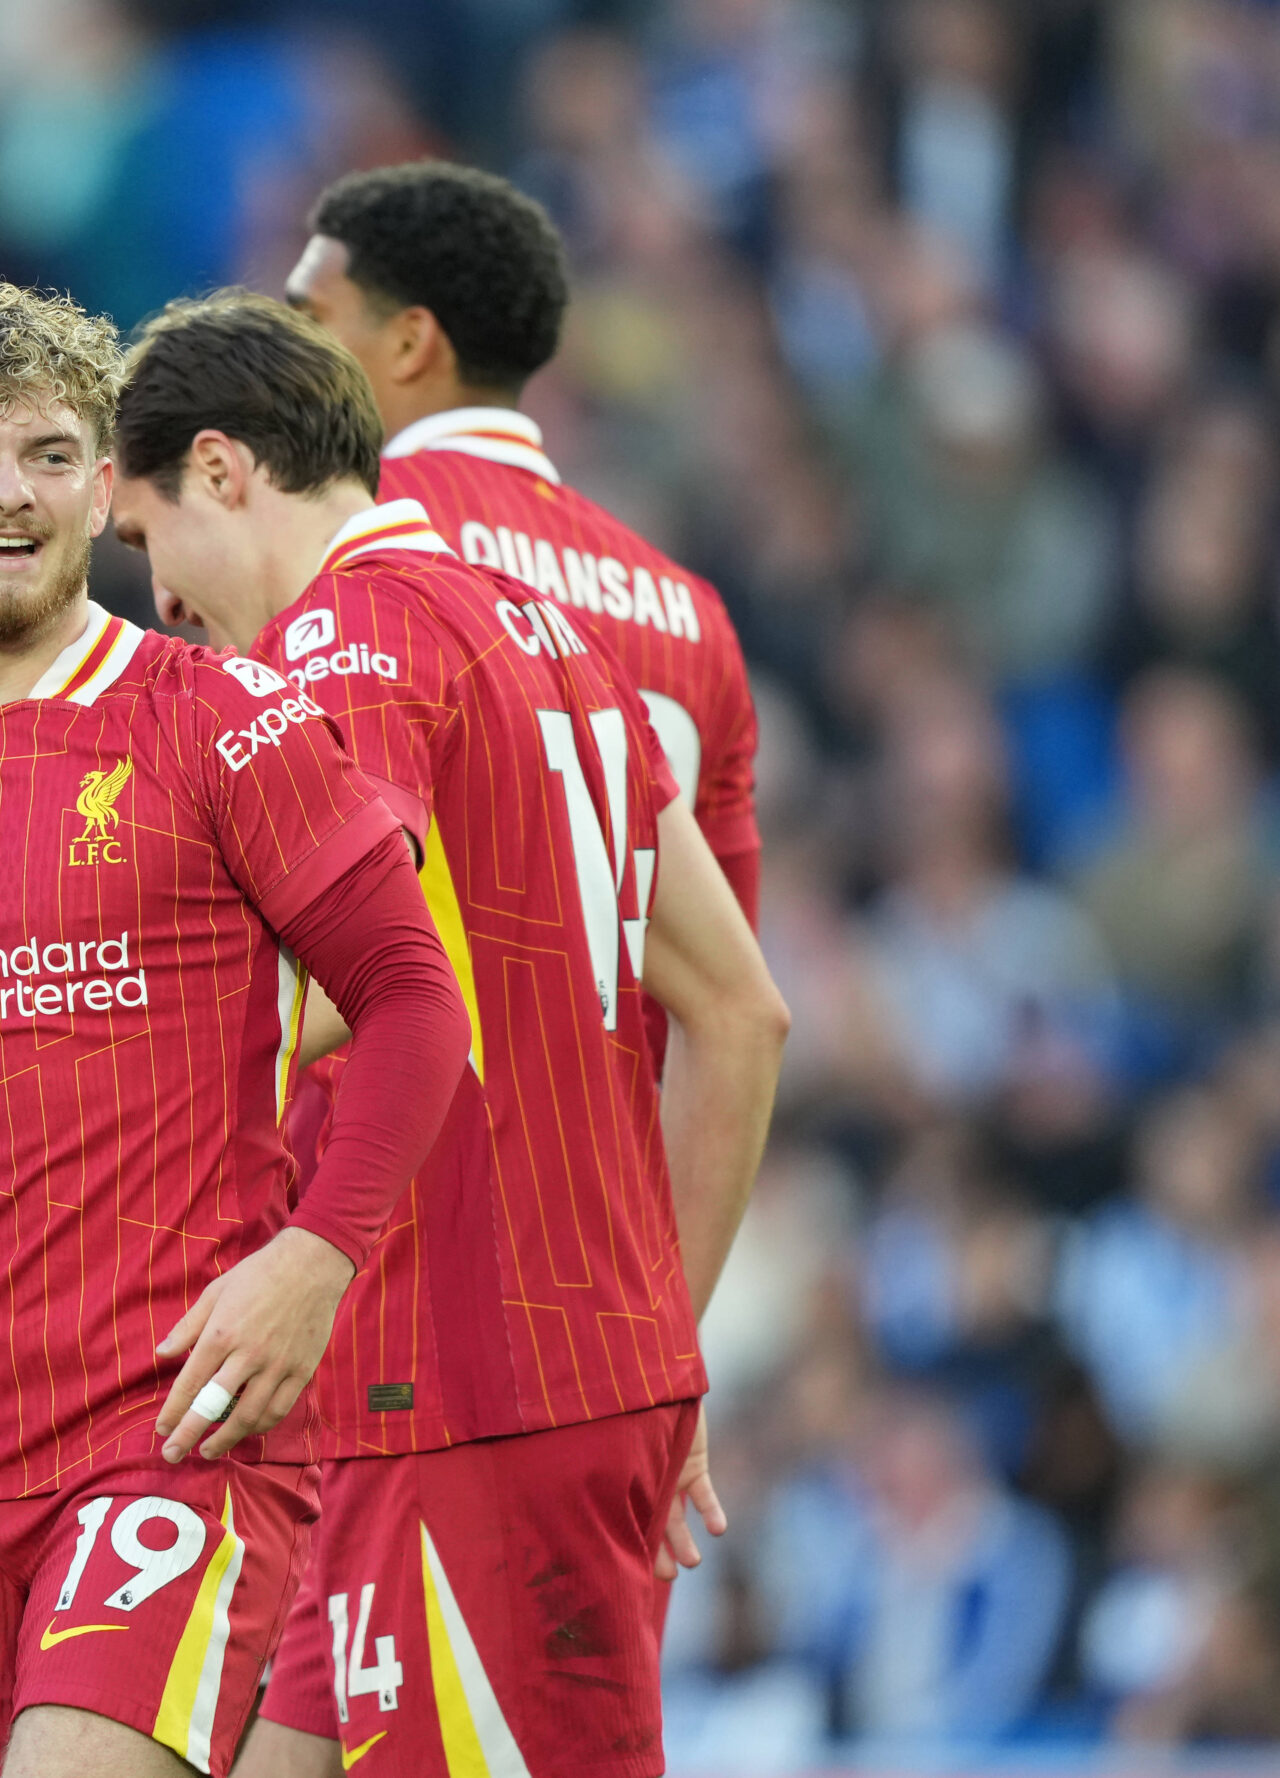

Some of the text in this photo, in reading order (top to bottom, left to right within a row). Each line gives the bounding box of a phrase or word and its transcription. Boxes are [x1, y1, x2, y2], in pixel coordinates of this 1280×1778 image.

[460, 520, 701, 644] QUANSAH
[68, 841, 128, 866] L.F.C.
[54, 1495, 208, 1613] 19
[327, 1583, 404, 1724] 14
